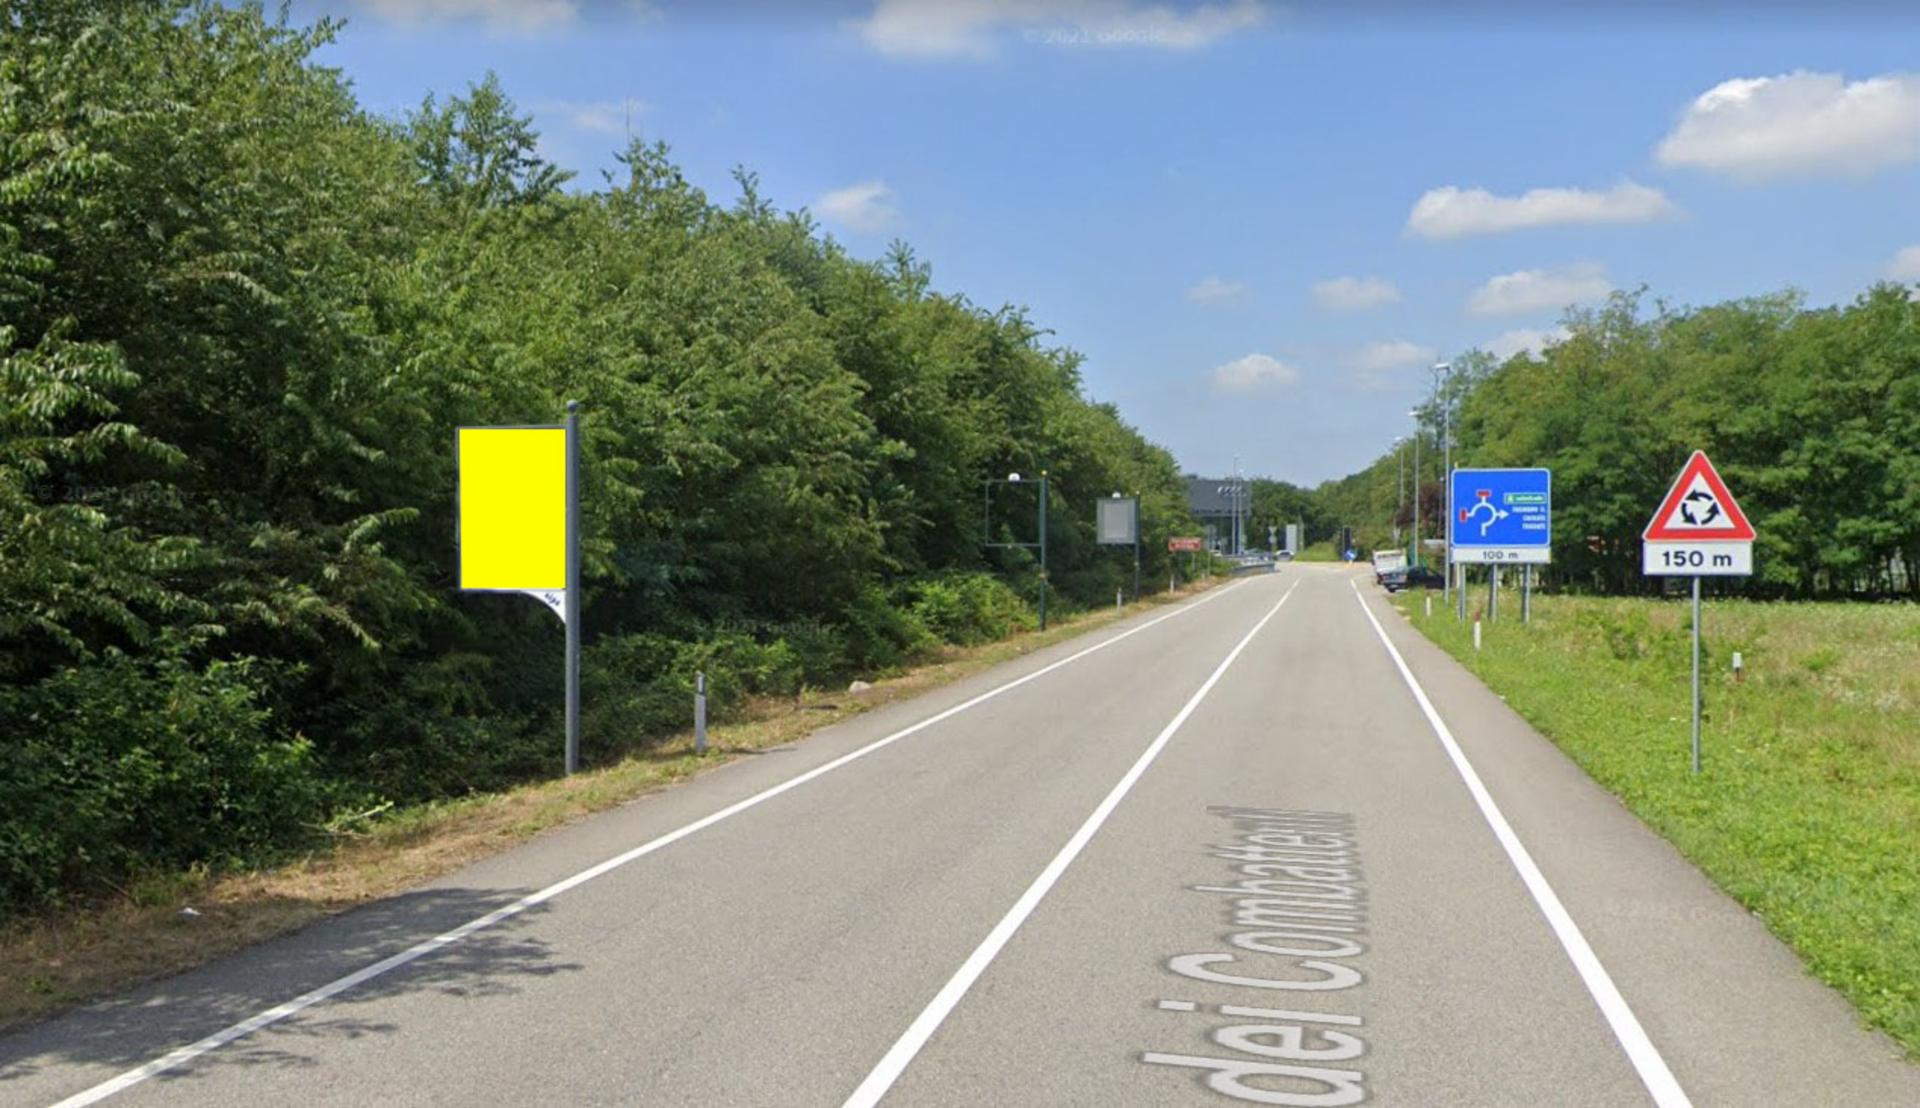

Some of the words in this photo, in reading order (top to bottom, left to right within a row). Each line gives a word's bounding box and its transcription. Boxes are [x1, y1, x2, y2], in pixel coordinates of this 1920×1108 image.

[1483, 551, 1504, 560] 100
[1662, 550, 1704, 567] 150
[1712, 554, 1732, 566] m
